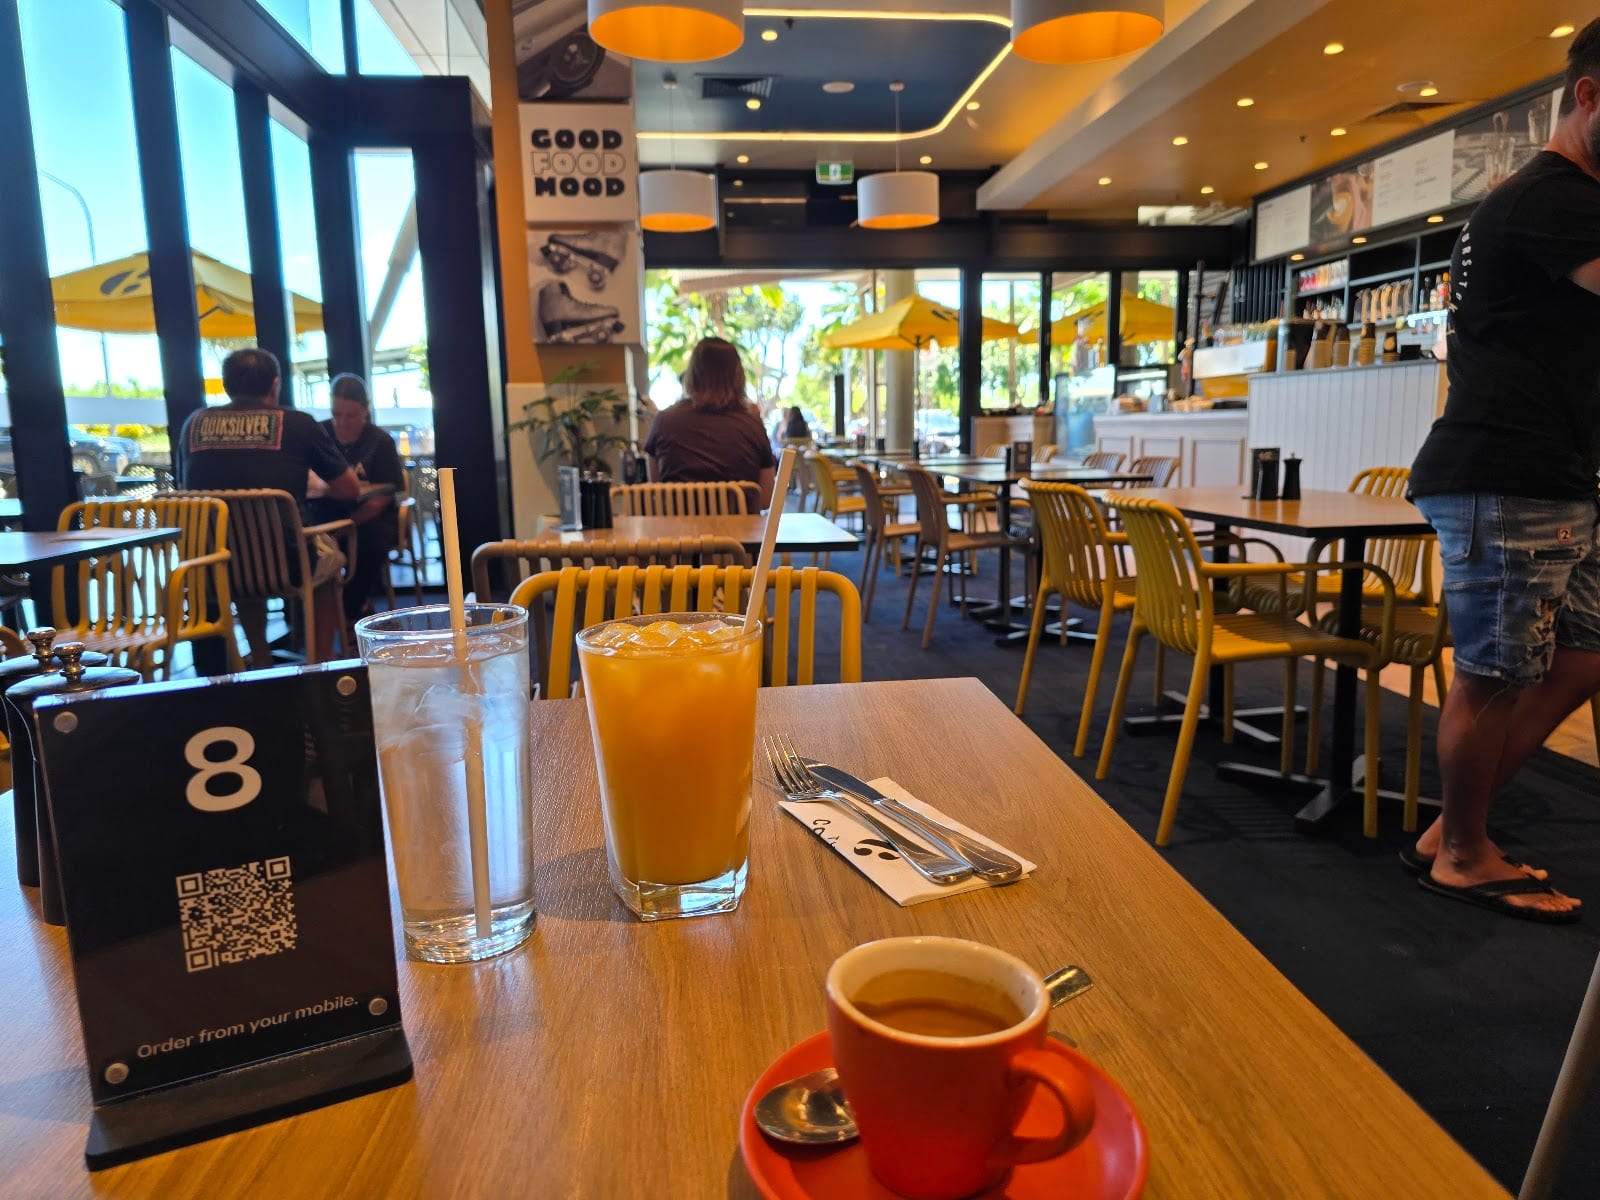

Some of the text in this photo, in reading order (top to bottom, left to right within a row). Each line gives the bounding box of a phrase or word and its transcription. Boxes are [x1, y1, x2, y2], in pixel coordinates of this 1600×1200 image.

[531, 129, 622, 150] GOOD
[531, 151, 626, 175] FOOD
[534, 177, 625, 197] MOOD
[184, 726, 262, 812] 8
[137, 995, 359, 1058] Order from your mobile.
